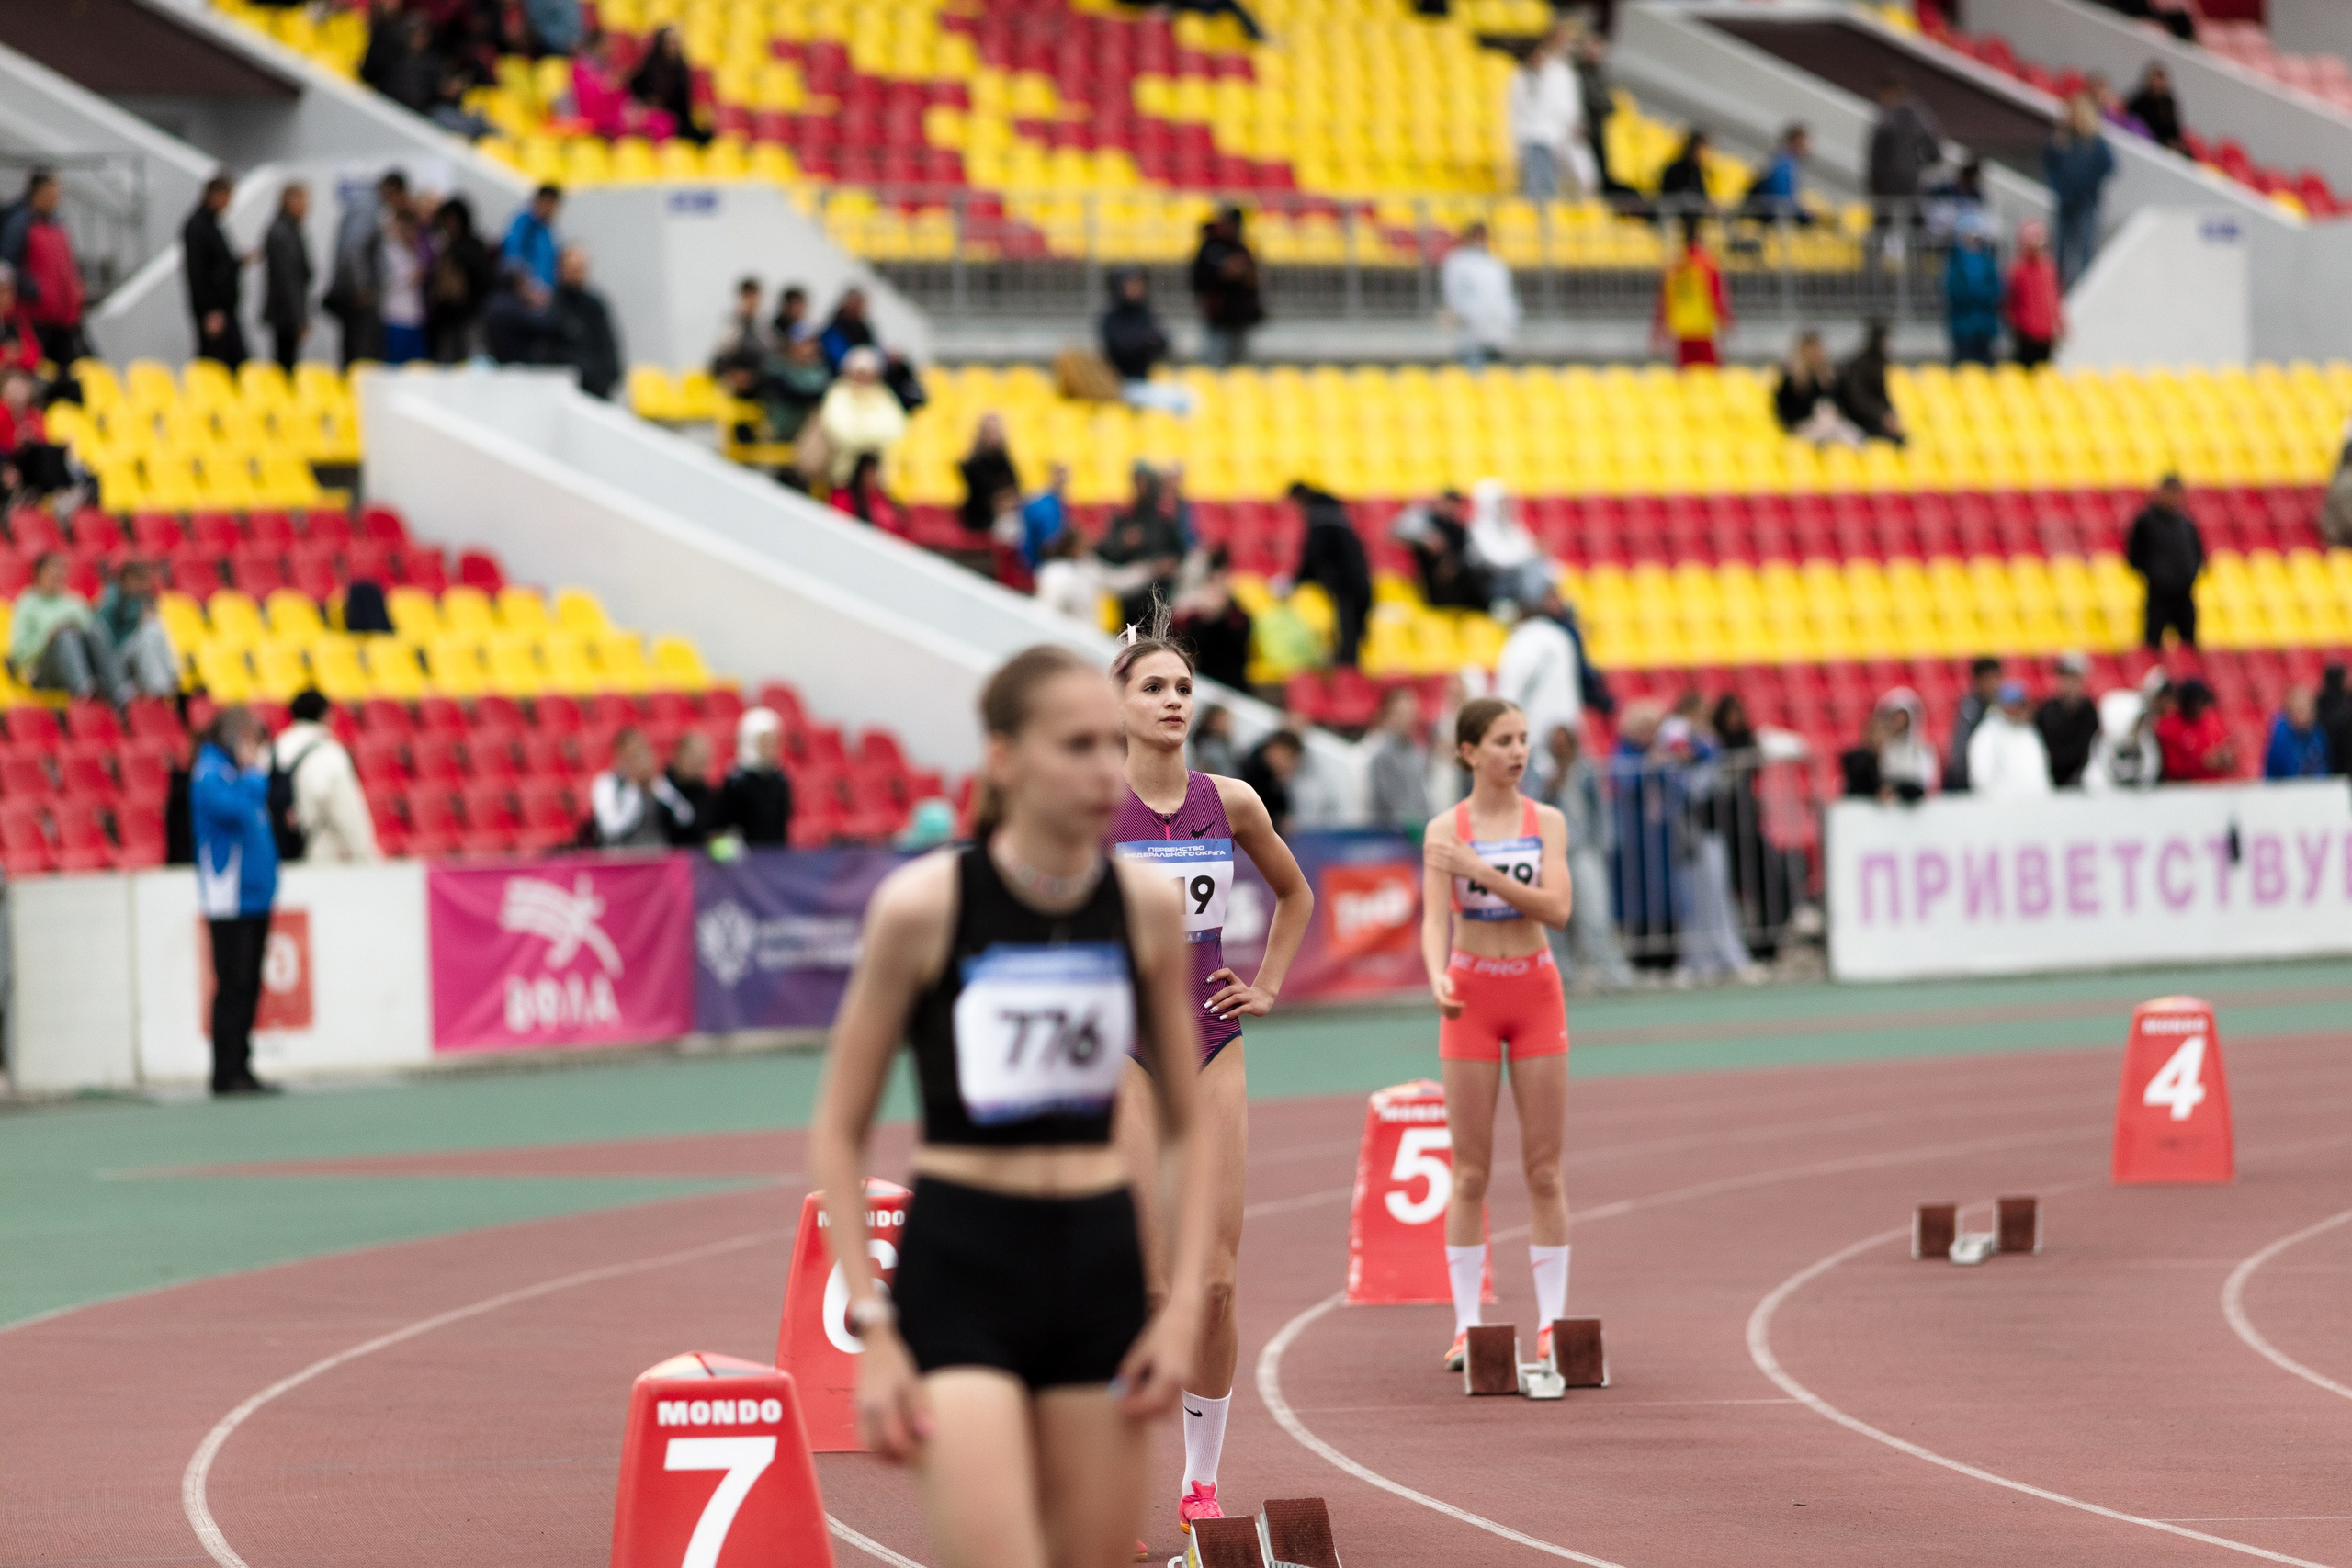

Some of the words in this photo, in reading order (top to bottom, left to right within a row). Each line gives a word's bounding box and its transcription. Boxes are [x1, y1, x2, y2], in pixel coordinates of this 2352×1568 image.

[1000, 1006, 1105, 1068] 776
[2143, 1036, 2206, 1120] 4
[1384, 1126, 1453, 1225] 5
[818, 1209, 906, 1227] MNDO
[822, 1238, 899, 1354] 6
[657, 1399, 783, 1426] MONDO
[663, 1436, 777, 1568] 7
